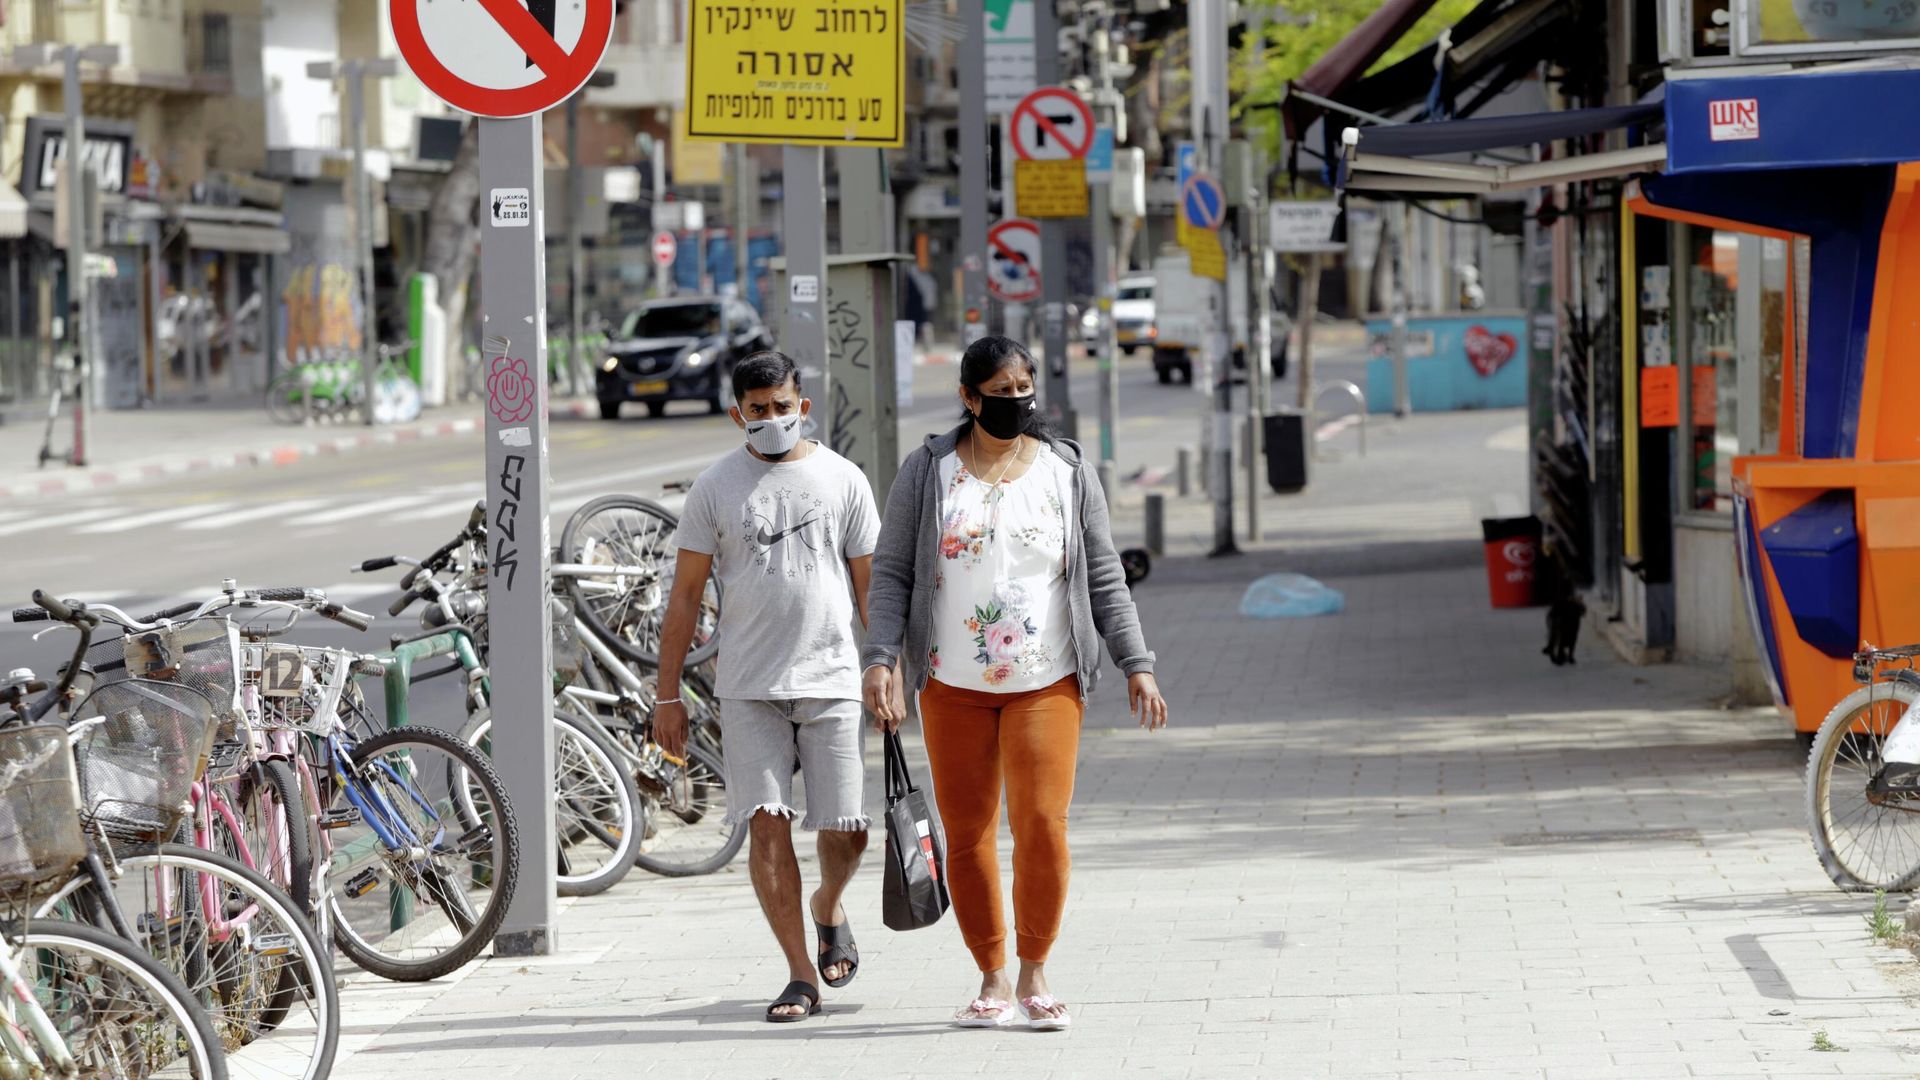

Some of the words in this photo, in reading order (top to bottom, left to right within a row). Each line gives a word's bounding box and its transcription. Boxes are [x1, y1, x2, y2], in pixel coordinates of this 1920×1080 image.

[705, 6, 796, 34] שיינקין
[815, 5, 888, 34] לרחוב
[737, 51, 854, 77] אסורה
[705, 92, 774, 119] חלופיות
[786, 95, 846, 121] בדרכים
[858, 98, 882, 121] סע
[264, 652, 303, 690] 12
